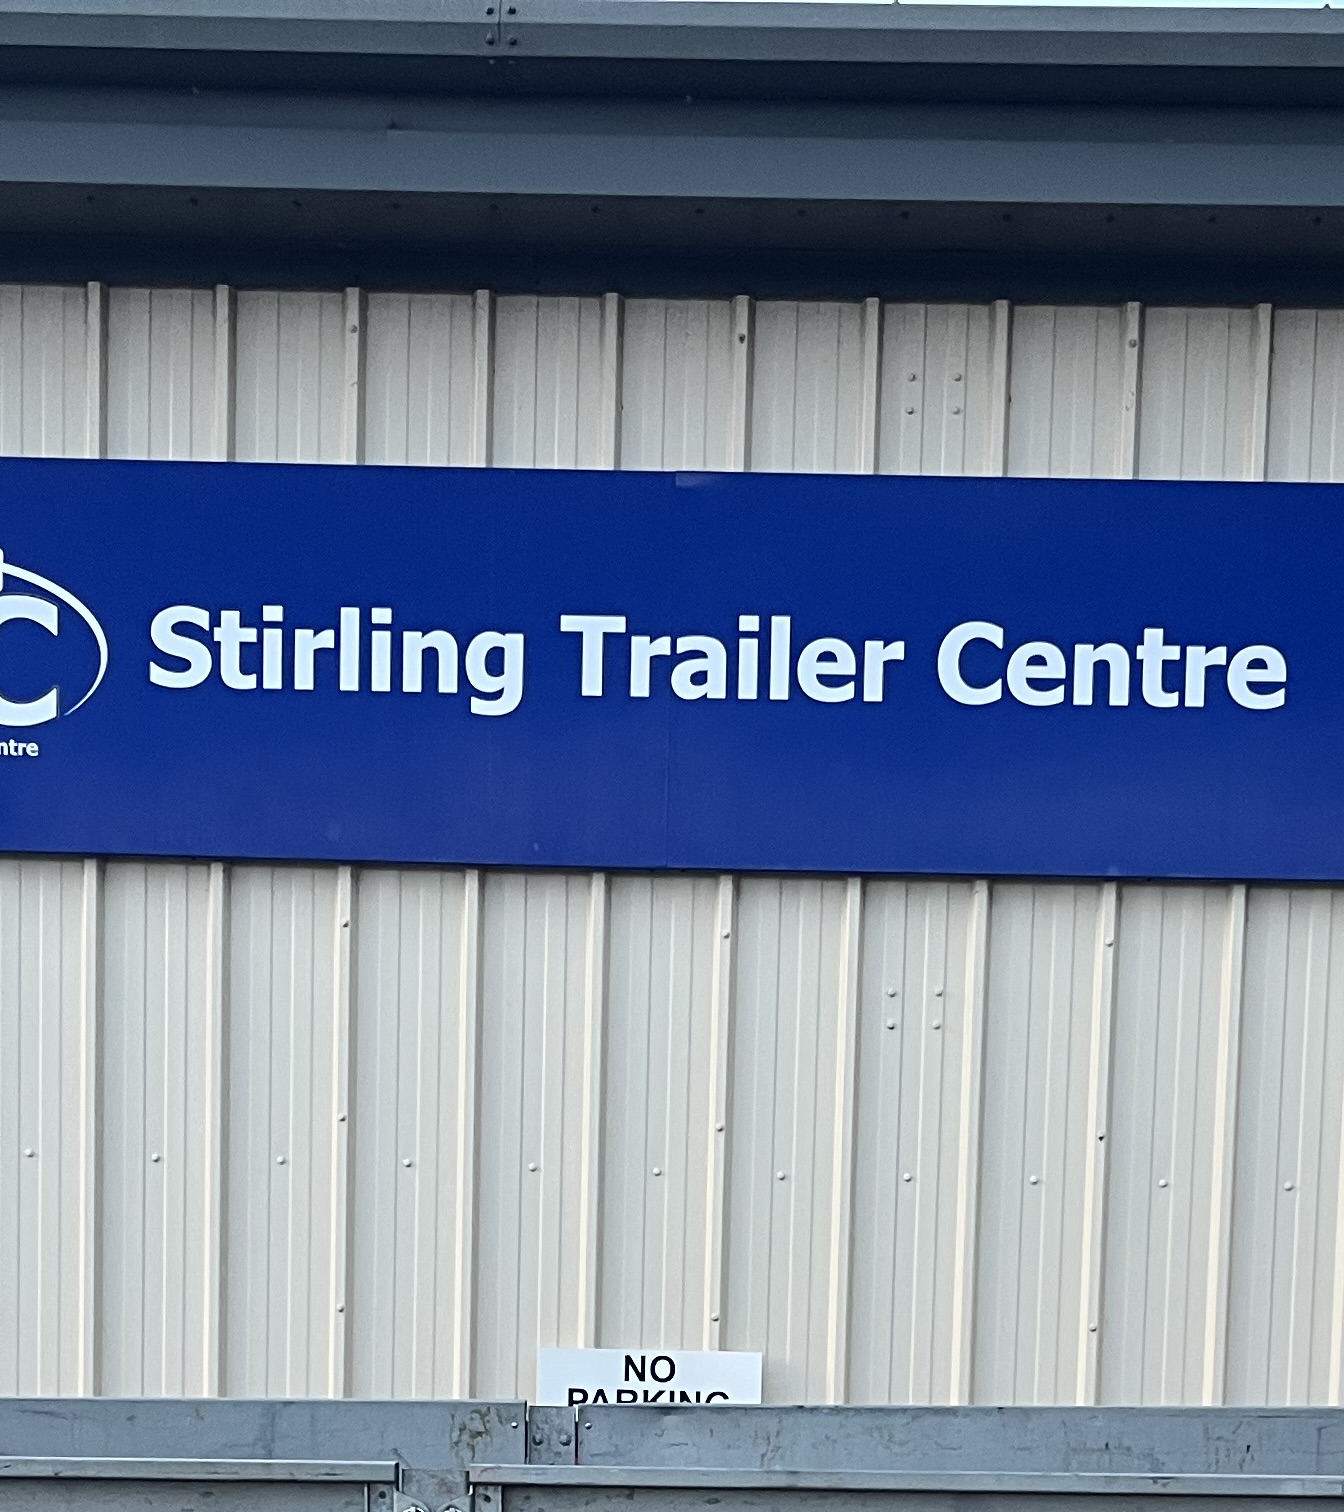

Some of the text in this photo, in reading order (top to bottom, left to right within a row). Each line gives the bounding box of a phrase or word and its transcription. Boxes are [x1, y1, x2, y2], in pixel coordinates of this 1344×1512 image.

[149, 605, 1287, 716] Stirling Trailer Centre
[624, 1354, 676, 1383] NO
